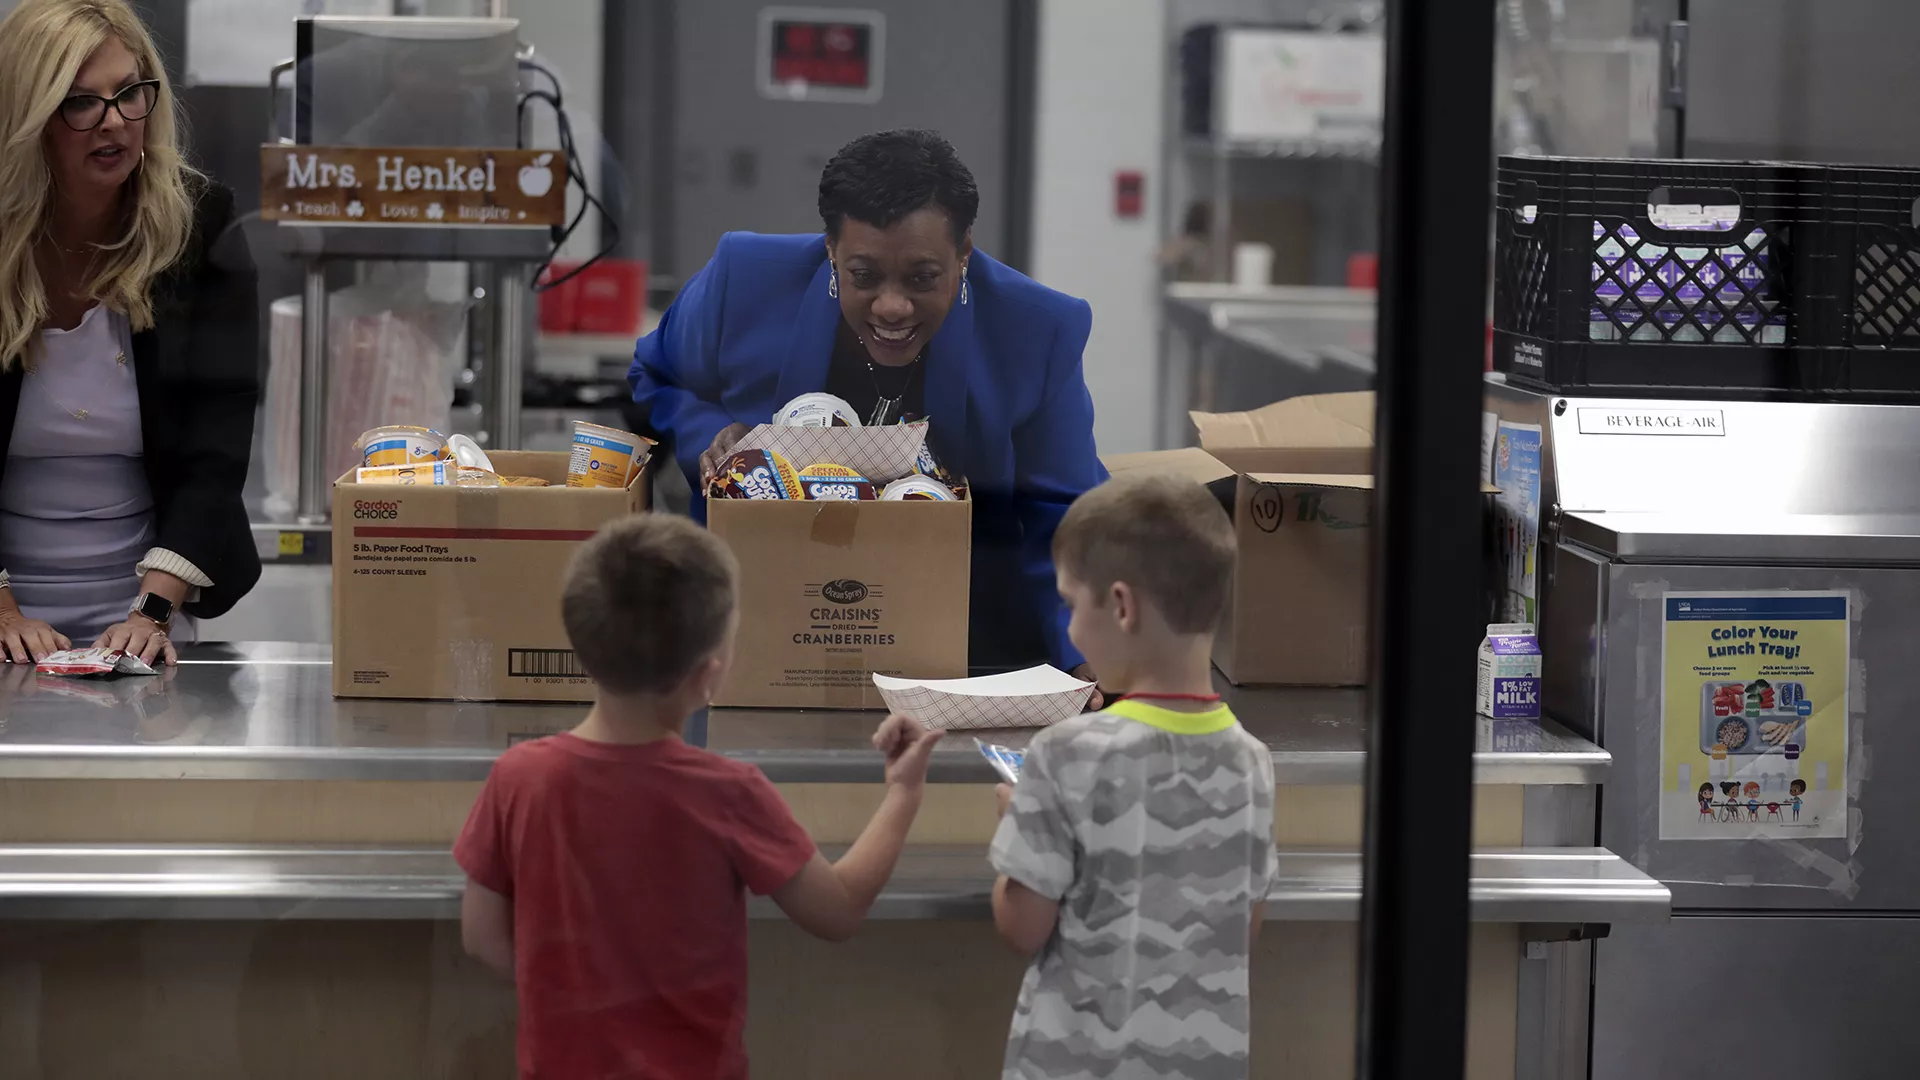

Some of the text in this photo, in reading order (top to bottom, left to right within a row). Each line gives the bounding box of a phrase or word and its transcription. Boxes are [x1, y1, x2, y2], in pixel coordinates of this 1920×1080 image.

[286, 154, 496, 192] Mrs. Henkel
[295, 202, 510, 221] Teach Love Inspire
[1606, 415, 1716, 428] BEVERAGE-AIR
[810, 483, 856, 497] Cocoa
[354, 544, 360, 552] 5
[361, 544, 372, 552] lb.
[374, 544, 399, 554] Paper
[425, 545, 449, 555] Trays
[825, 586, 845, 599] Ocean
[845, 588, 862, 600] Spray
[792, 633, 896, 645] CRANBERRIES
[1711, 626, 1798, 640] Color Your
[1708, 642, 1800, 659] Lunch Tray!
[1498, 656, 1536, 664] LOCAL
[1501, 681, 1518, 692] 1%
[1496, 692, 1537, 704] MILK
